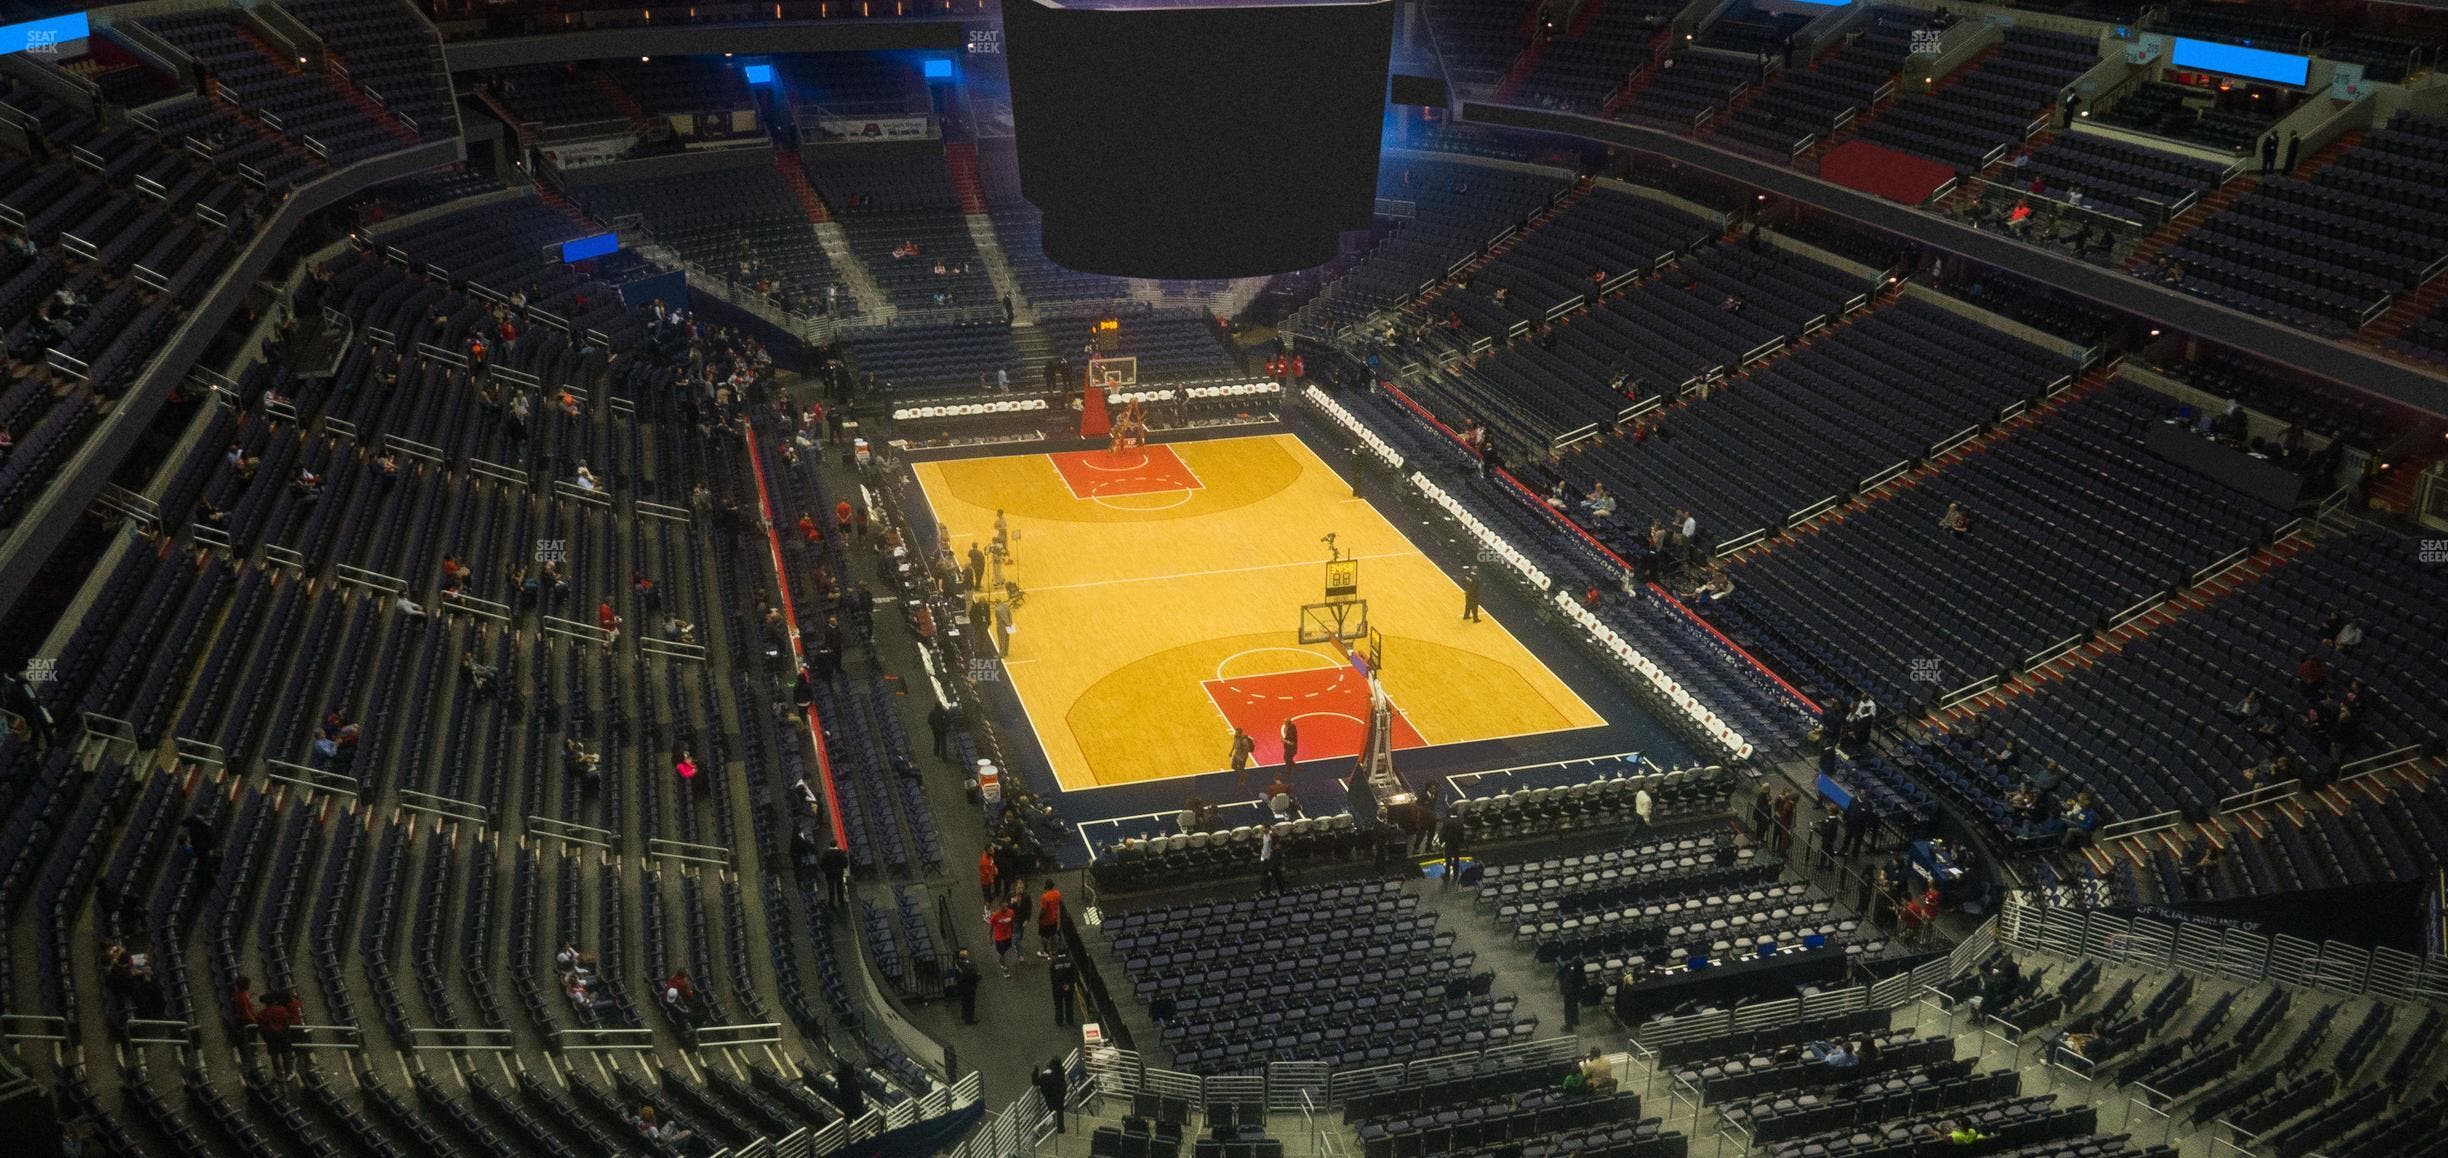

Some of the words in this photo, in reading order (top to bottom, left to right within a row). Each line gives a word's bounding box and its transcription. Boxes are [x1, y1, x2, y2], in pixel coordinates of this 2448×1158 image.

[2136, 905, 2189, 921] OFICIAL
[2192, 914, 2240, 928] AIRLINE
[2242, 921, 2262, 931] OF
